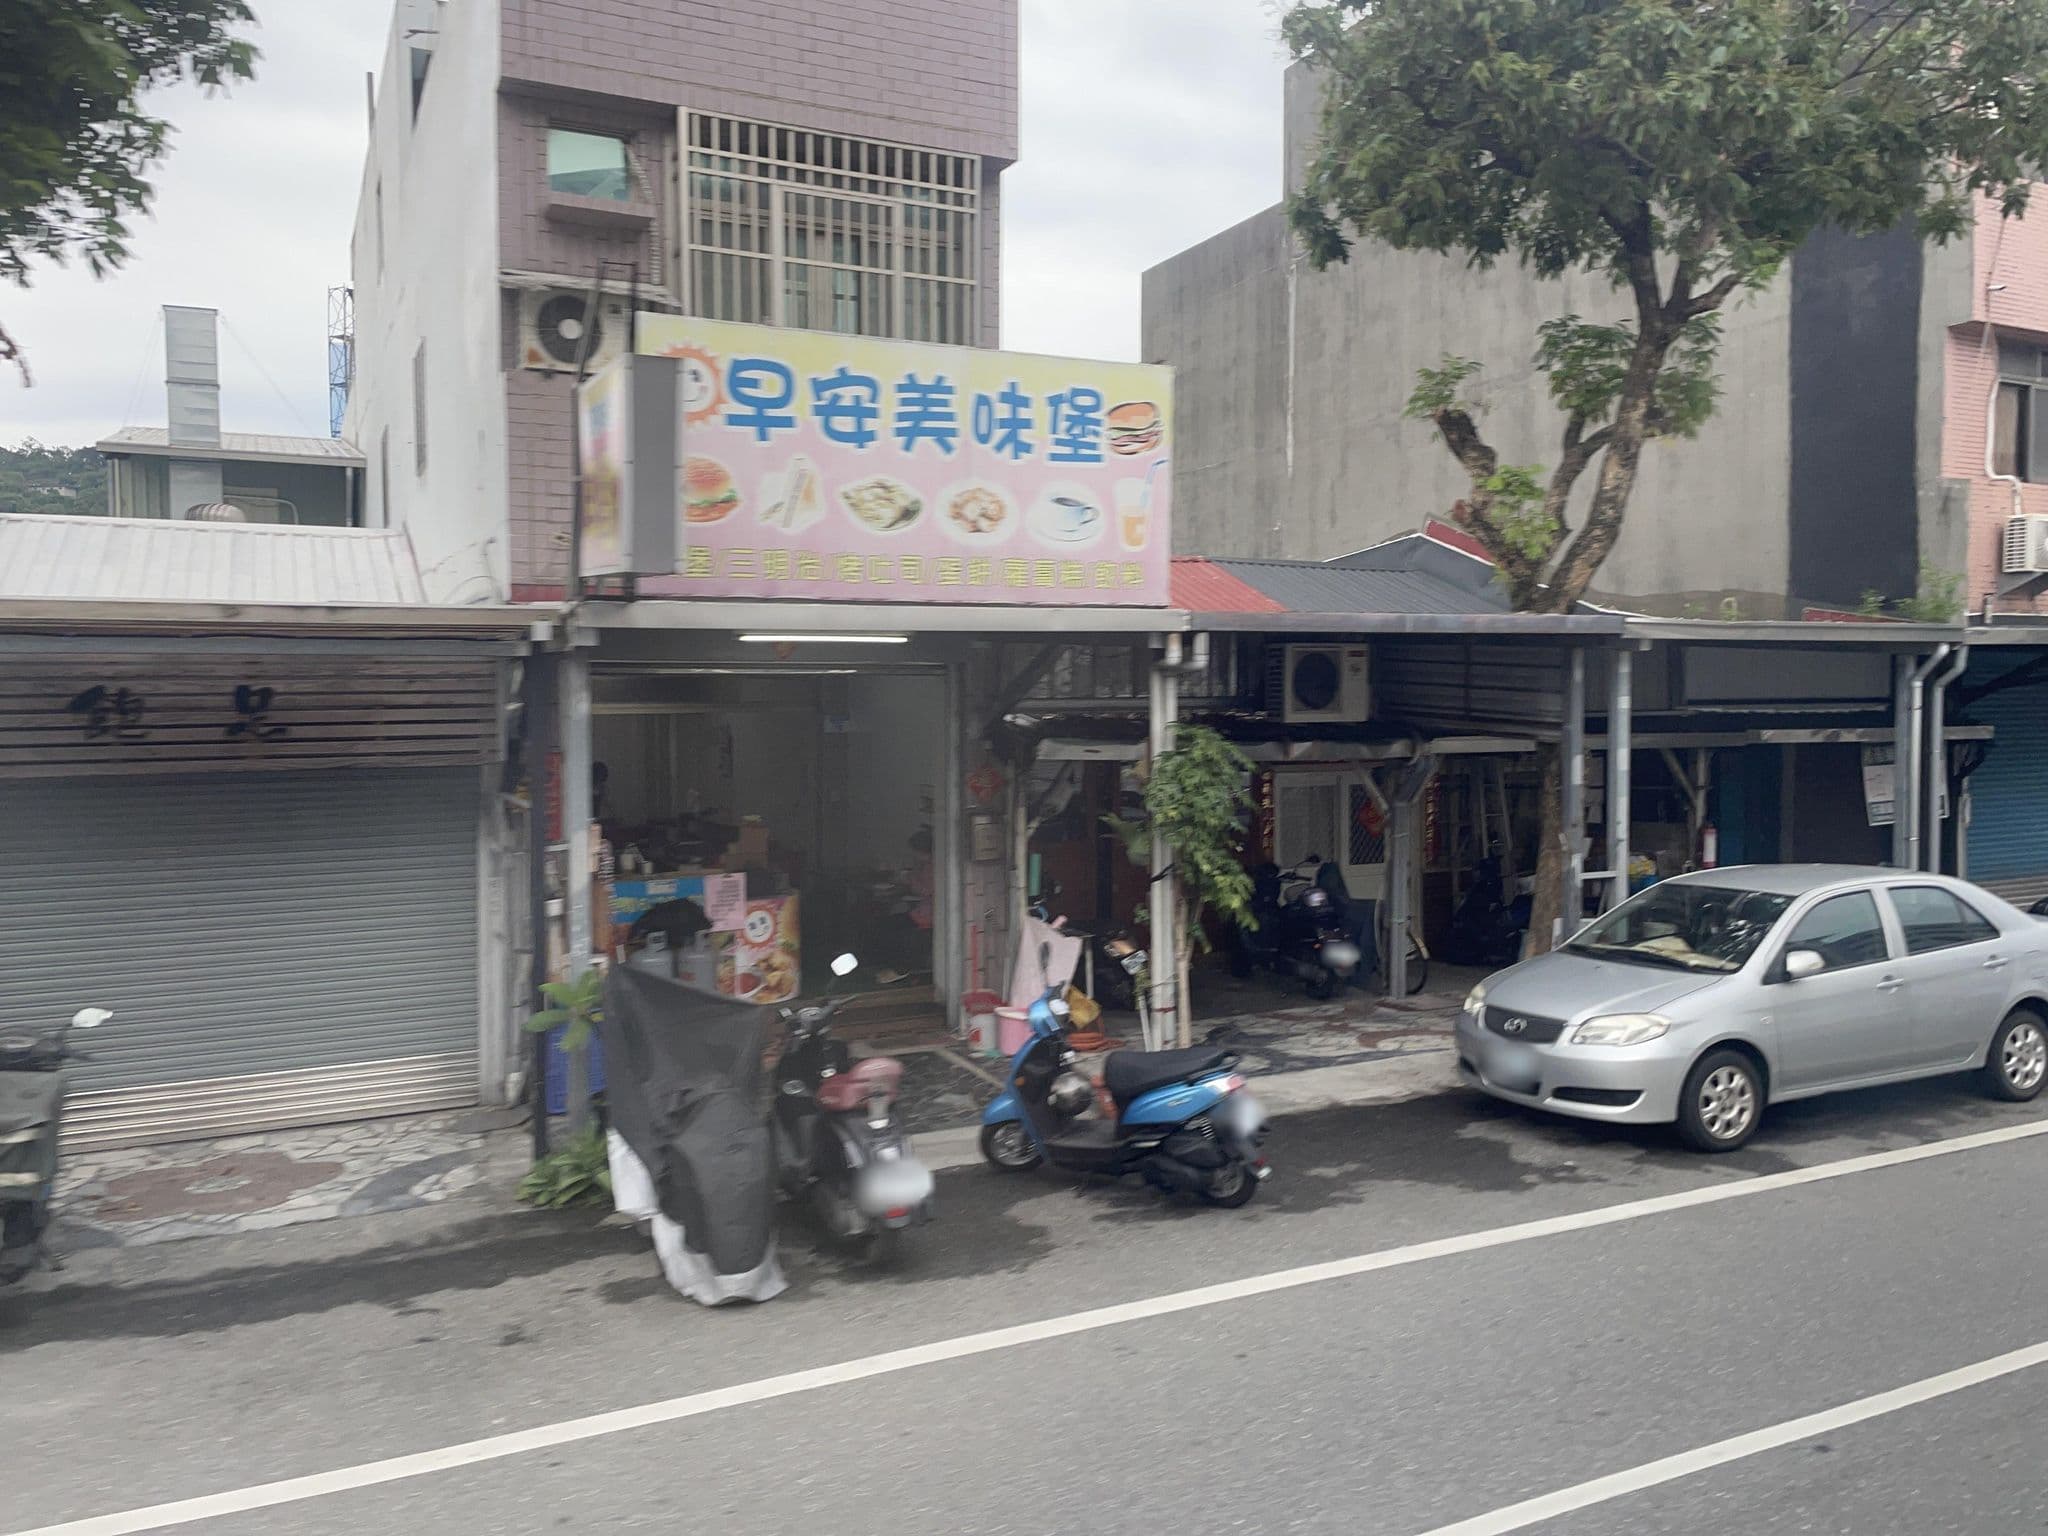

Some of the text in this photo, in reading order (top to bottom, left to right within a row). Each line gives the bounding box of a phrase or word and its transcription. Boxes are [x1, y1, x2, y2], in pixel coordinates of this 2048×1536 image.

[726, 357, 1105, 464] 早安美味堡
